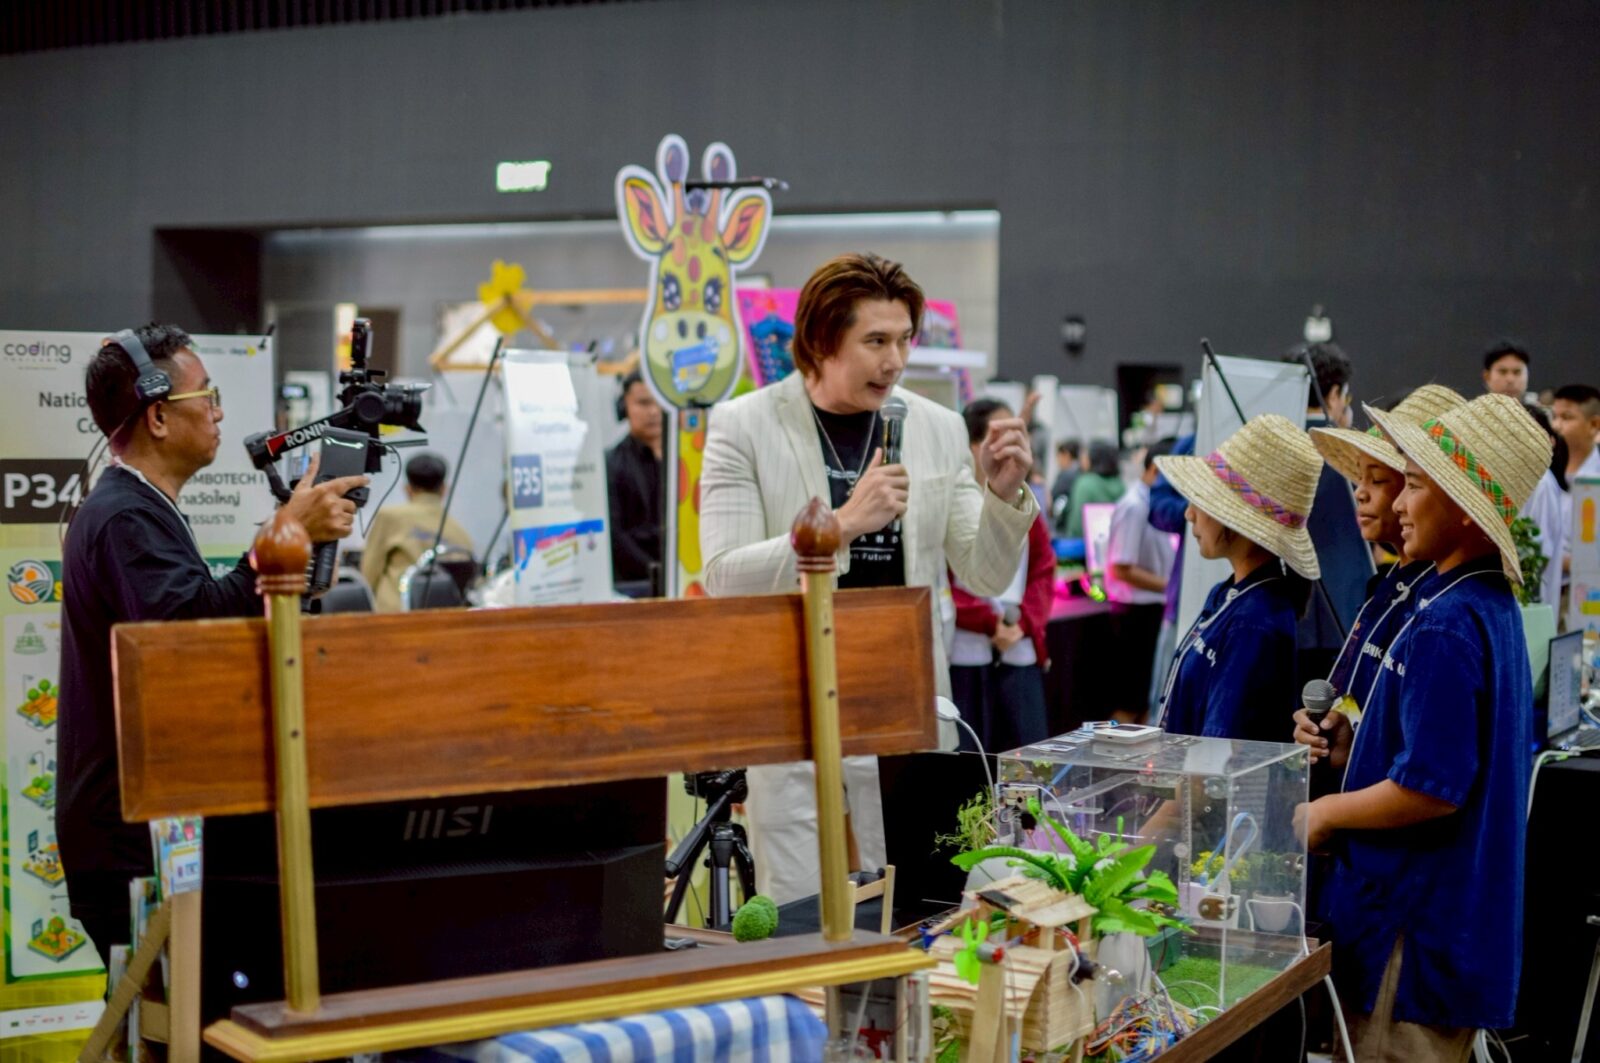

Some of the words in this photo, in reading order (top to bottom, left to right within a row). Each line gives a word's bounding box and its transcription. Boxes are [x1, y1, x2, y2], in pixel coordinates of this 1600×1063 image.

[4, 341, 72, 363] coding
[39, 392, 87, 408] Natio
[77, 417, 99, 433] Co
[4, 472, 81, 509] P34
[513, 466, 542, 497] P35
